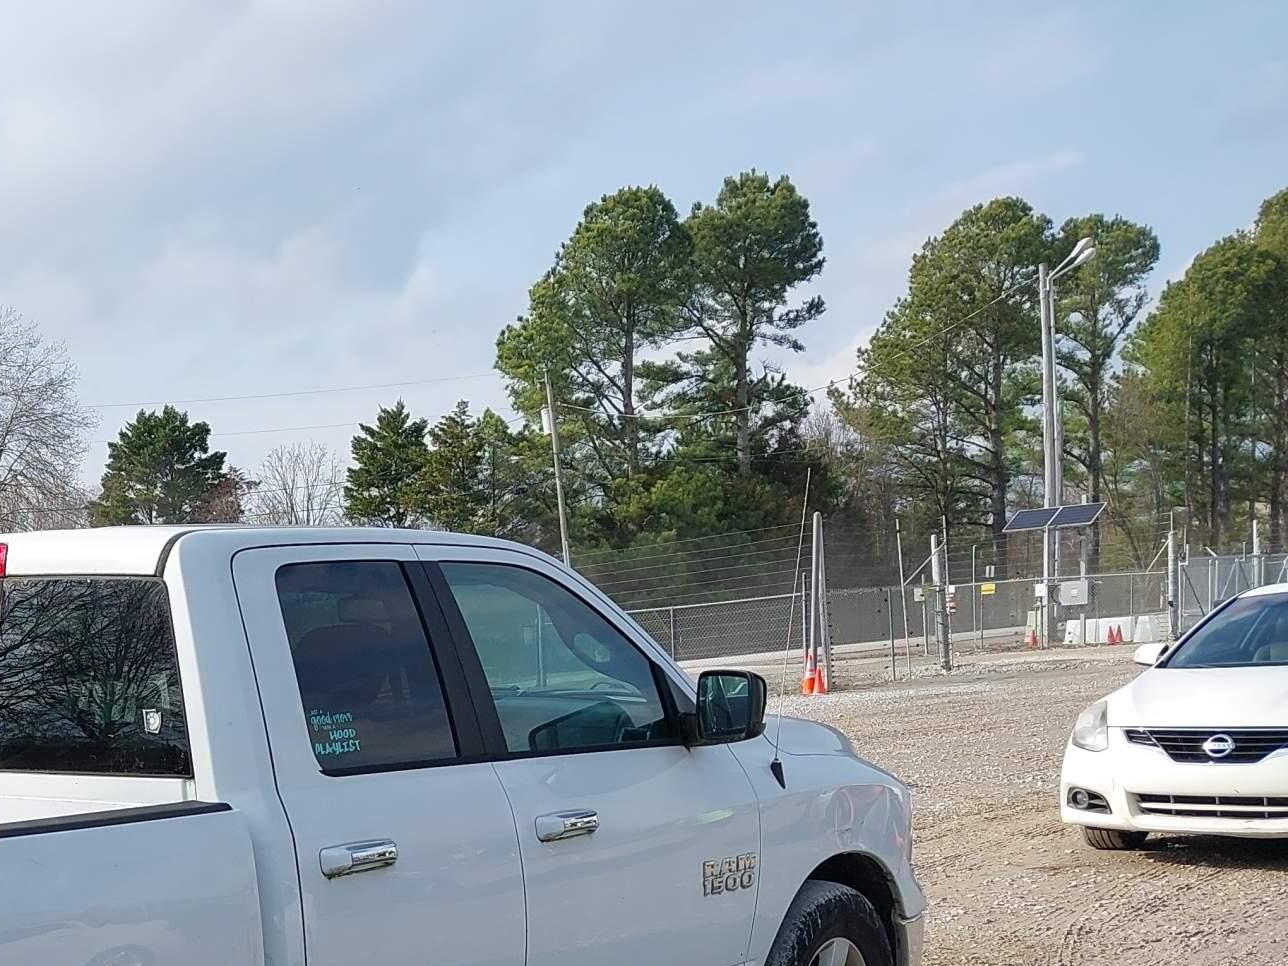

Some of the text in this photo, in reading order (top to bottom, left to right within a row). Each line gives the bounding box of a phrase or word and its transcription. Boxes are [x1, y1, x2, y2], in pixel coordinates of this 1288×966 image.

[310, 711, 332, 731] good
[329, 728, 356, 740] HOOD
[315, 739, 361, 755] PLAYLIST
[703, 852, 756, 878] RAM
[703, 870, 755, 897] 1500
